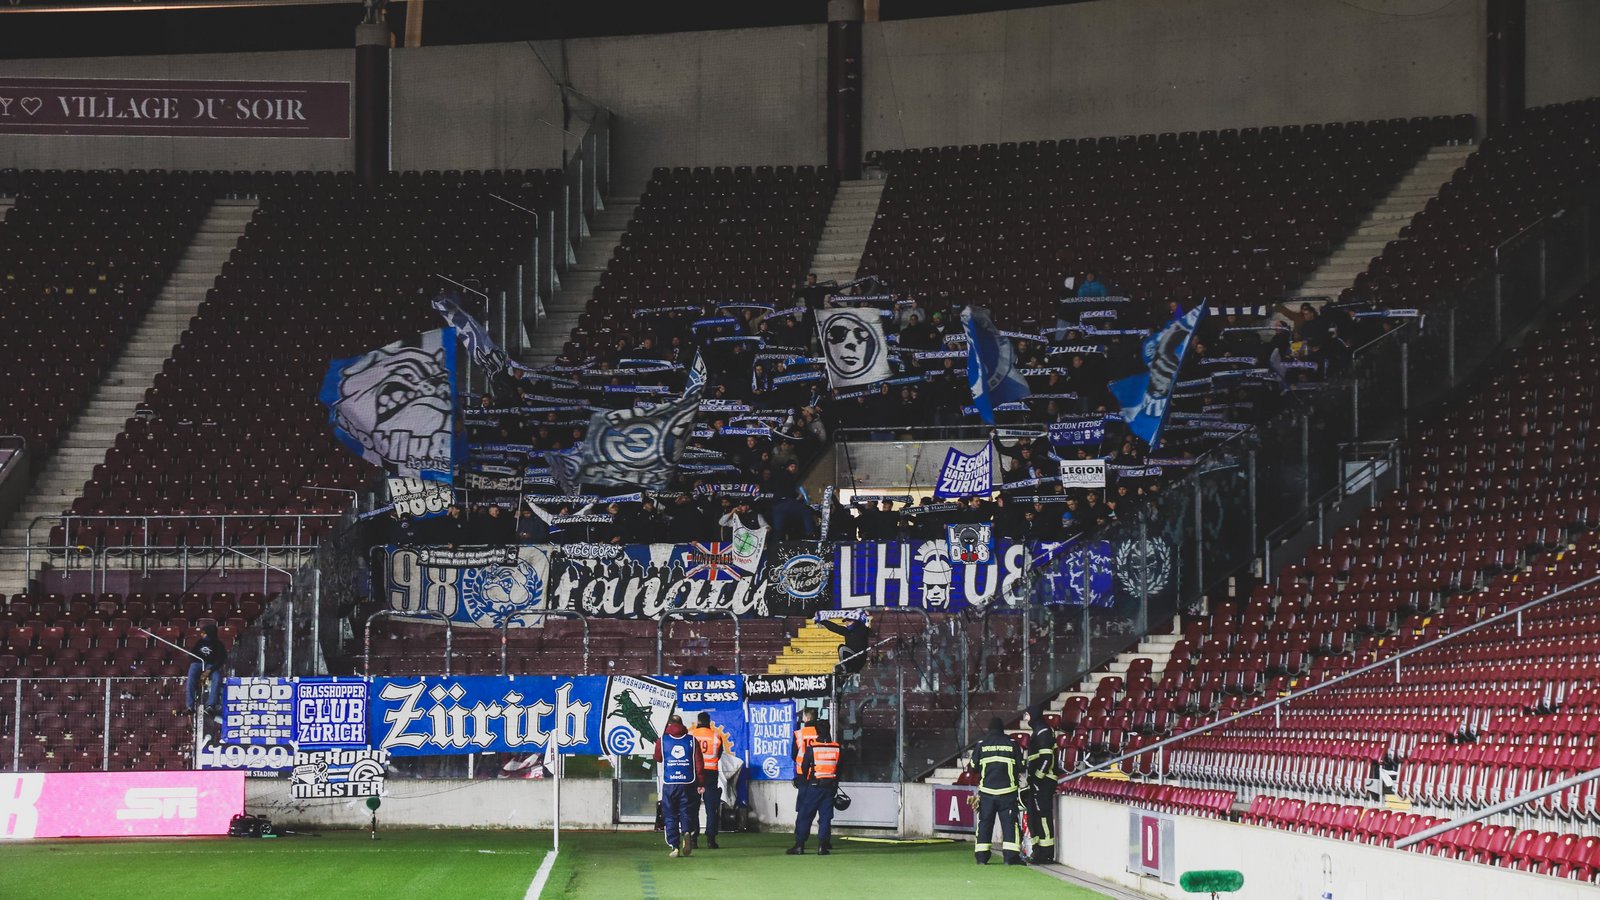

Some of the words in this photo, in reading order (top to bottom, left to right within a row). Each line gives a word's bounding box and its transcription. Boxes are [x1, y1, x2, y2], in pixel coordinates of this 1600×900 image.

[58, 96, 179, 120] VILLAGE
[236, 98, 307, 121] SOIR
[300, 685, 364, 698] GRASSHOPPER
[684, 680, 703, 690] KEI
[707, 680, 736, 690] HASS
[682, 692, 703, 702] KEI
[703, 692, 739, 702] SPASS
[227, 714, 292, 727] DRAH
[300, 699, 364, 724] CLUB
[379, 681, 592, 750] Zürich
[769, 707, 792, 722] DICH
[227, 728, 292, 739] GLAUBE
[299, 723, 364, 743] ZÜRICH
[753, 737, 790, 756] BEREIT
[207, 745, 289, 769] 1929
[291, 781, 385, 798] MEISTER
[949, 796, 960, 821] A
